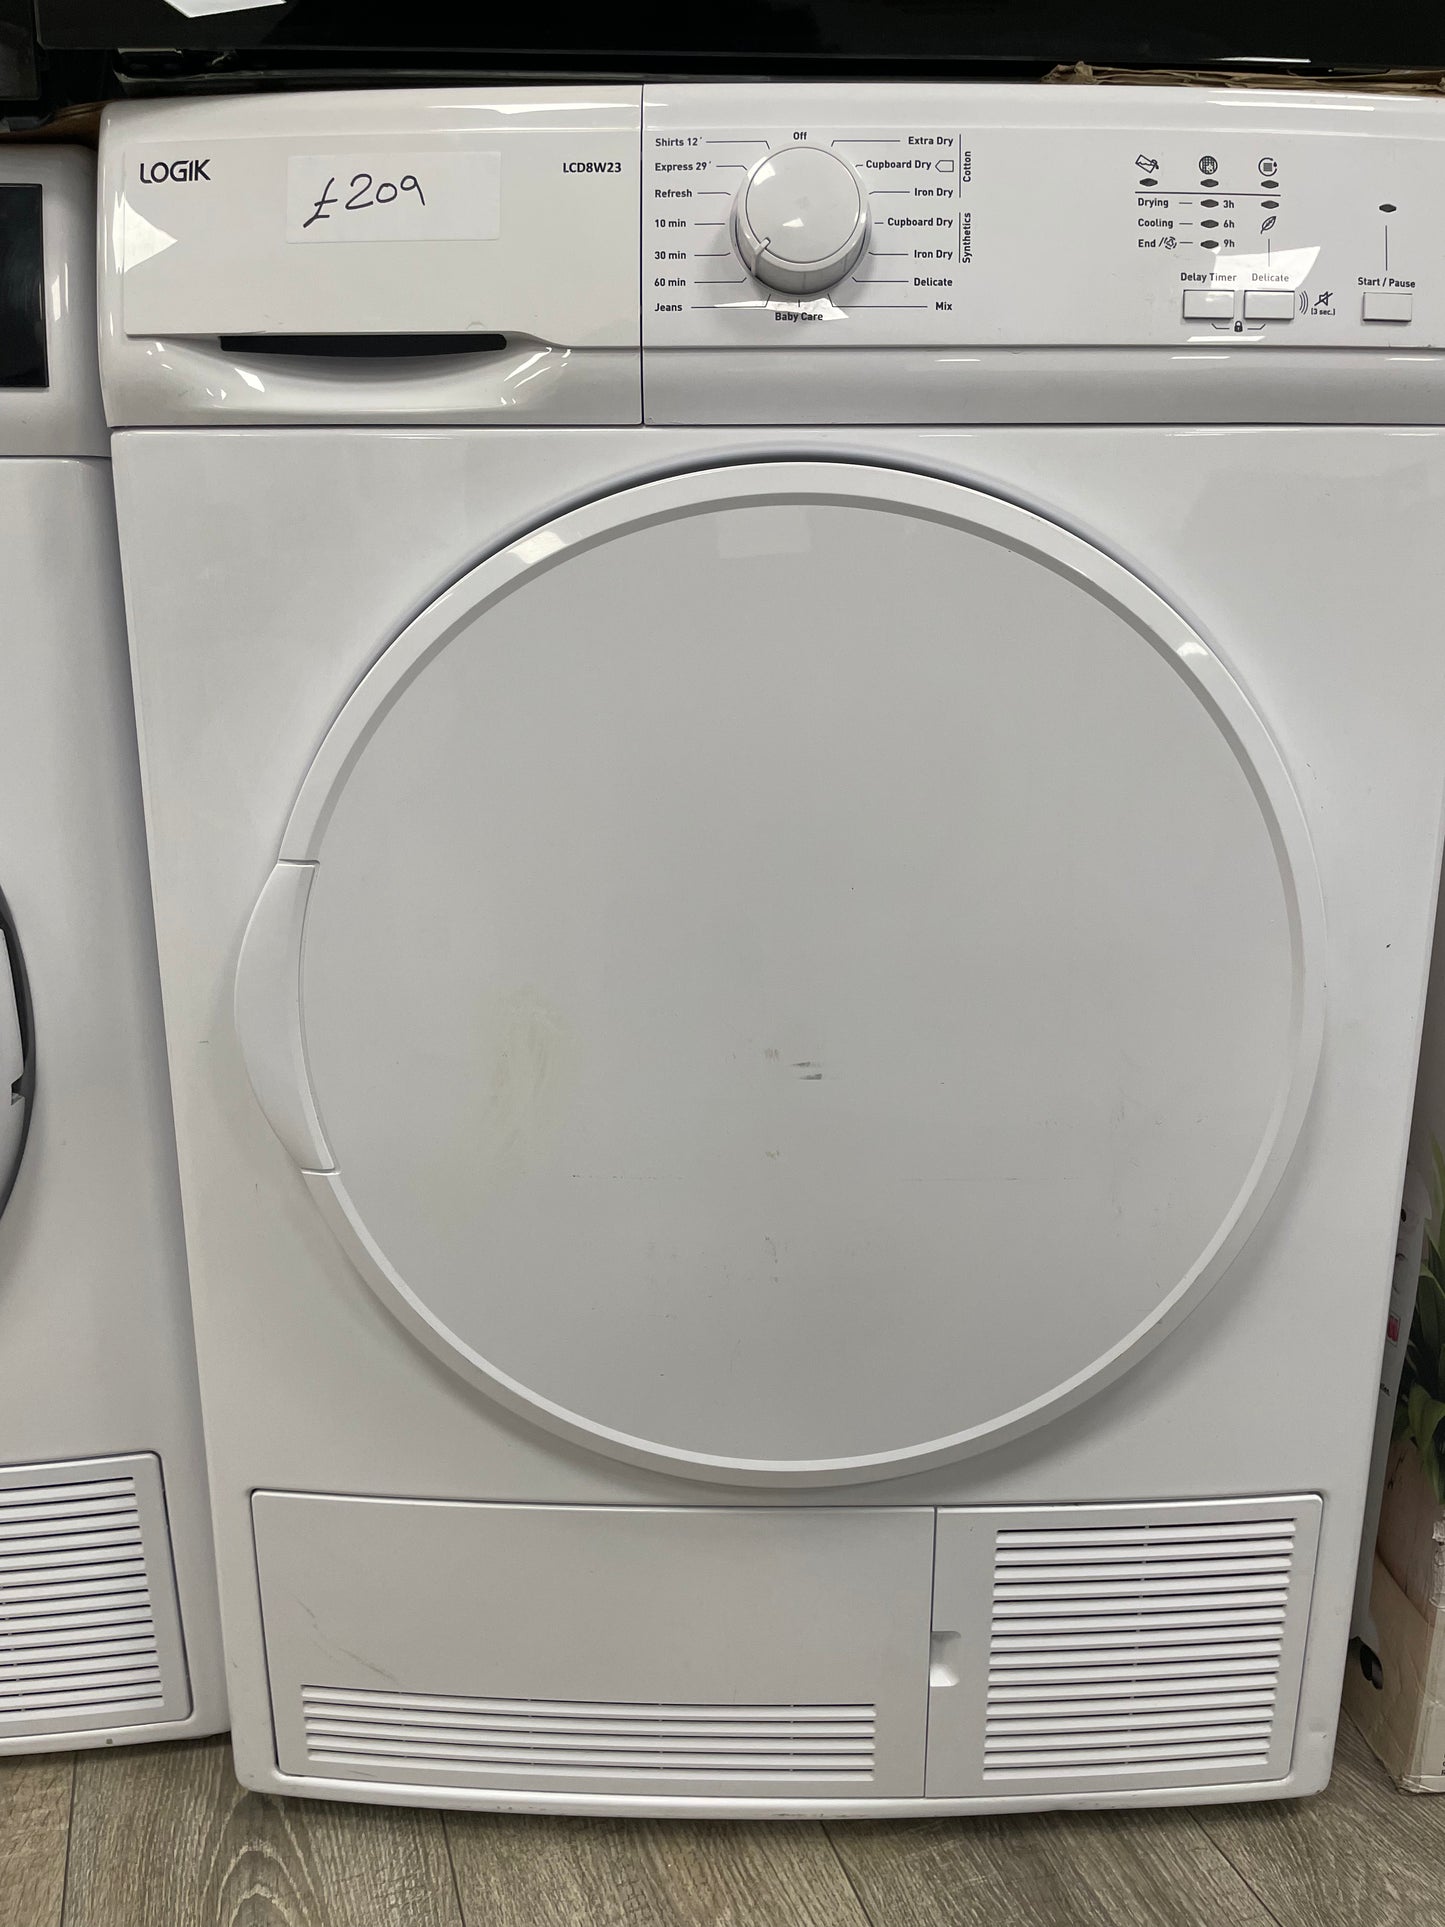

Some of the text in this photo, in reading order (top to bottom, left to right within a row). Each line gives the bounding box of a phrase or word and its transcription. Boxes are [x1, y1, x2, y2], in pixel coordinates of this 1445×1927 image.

[793, 131, 807, 140] Off
[907, 135, 954, 147] Extra Dry
[655, 138, 684, 147] Shirts
[563, 162, 621, 173] LCD8W23
[655, 162, 693, 173] Express
[866, 159, 932, 171] Cupboard Dry
[962, 151, 972, 183] Cotton
[140, 159, 211, 184] LOGIK
[655, 189, 692, 198] Refresh
[914, 187, 953, 198] Iron Dry
[303, 173, 425, 228] £209
[1138, 197, 1169, 208] Drying
[1223, 200, 1234, 208] 3h
[655, 218, 686, 228] 10 min
[887, 217, 953, 228] Cupboard Dry
[1138, 218, 1173, 229] Cooling
[1223, 219, 1235, 228] 6h
[962, 212, 973, 263] Synthetics
[1138, 239, 1156, 248] End
[1223, 239, 1235, 248] 9h
[654, 250, 686, 260] 30 min
[914, 249, 953, 260] Iron Dry
[654, 277, 686, 287] 60 min
[914, 277, 953, 286] Delicate
[1180, 272, 1237, 283] Delay Timer
[1252, 273, 1289, 282] Delicate
[1358, 277, 1380, 286] Start
[1389, 278, 1416, 288] Pause
[654, 303, 683, 312] Jeans
[935, 301, 952, 311] Mix
[775, 311, 823, 323] Baby Care
